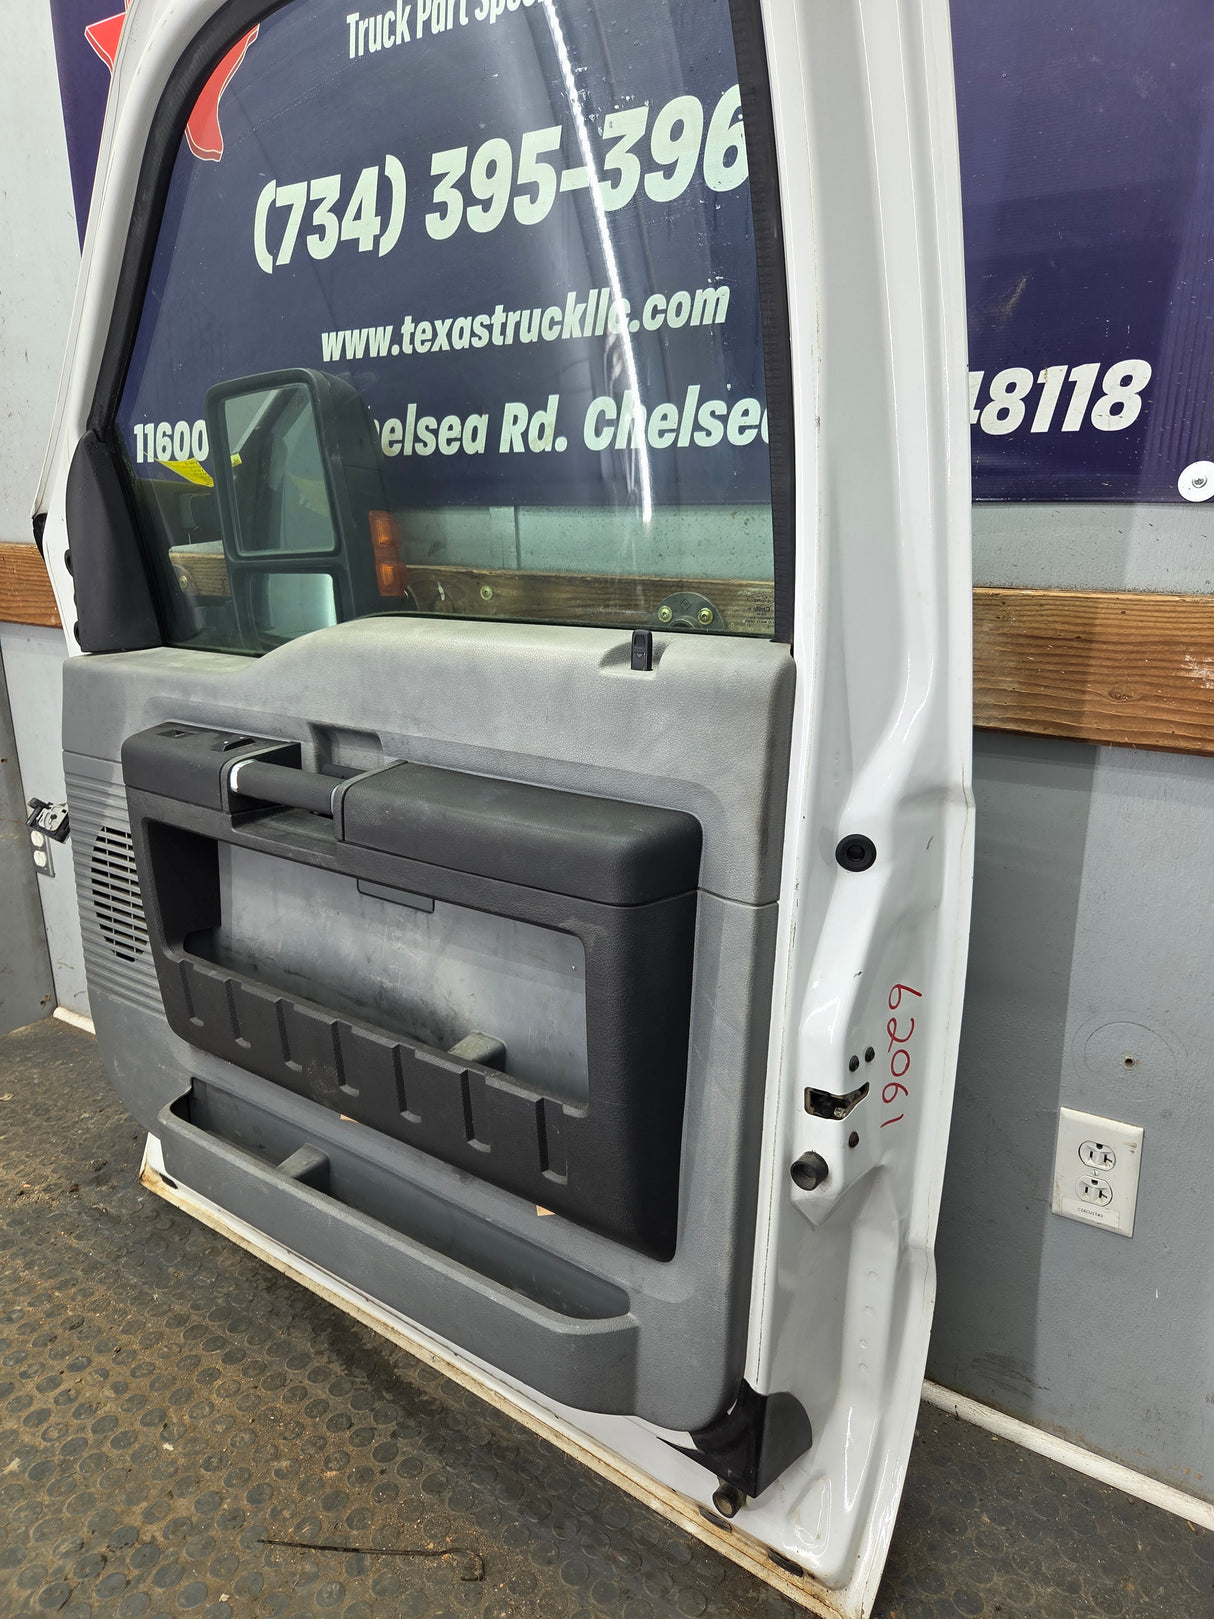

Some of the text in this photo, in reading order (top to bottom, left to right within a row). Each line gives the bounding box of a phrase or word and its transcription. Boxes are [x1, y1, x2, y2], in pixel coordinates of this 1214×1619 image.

[347, 0, 411, 58] Truck
[416, 0, 468, 39] Part
[254, 83, 749, 274] (734) 395-396
[321, 285, 730, 362] www.texastruckllc.com
[133, 419, 209, 463] 11600
[374, 403, 489, 456] elsea
[499, 394, 568, 453] Rd.
[584, 385, 769, 452] Chelse
